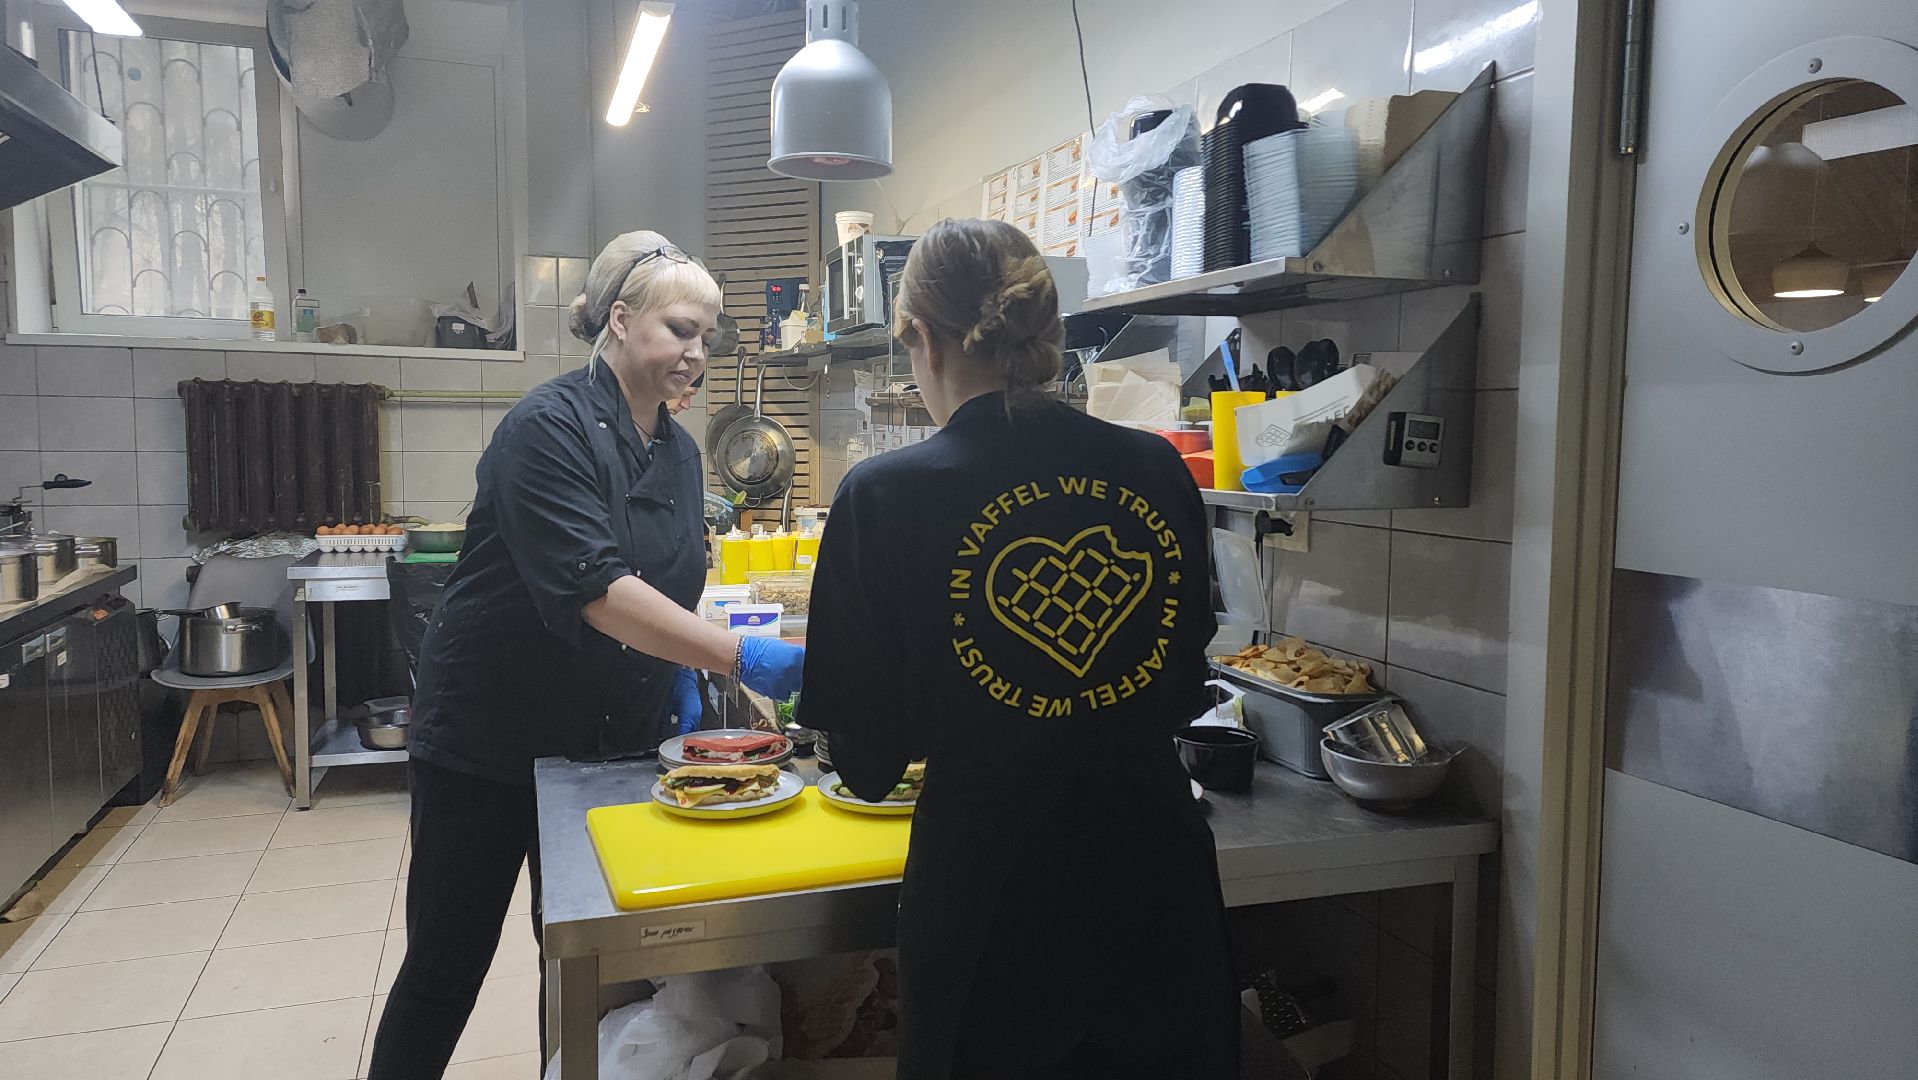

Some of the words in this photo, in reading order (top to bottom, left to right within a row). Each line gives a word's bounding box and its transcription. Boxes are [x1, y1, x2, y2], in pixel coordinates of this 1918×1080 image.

[1057, 476, 1109, 500] WE
[957, 481, 1050, 557] VAFFEL
[1118, 486, 1182, 561] TRUST
[950, 568, 972, 599] IN
[1161, 598, 1179, 628] IN
[952, 636, 1023, 708] TRUST
[1080, 637, 1169, 710] VAFFEL
[1028, 694, 1072, 718] WE
